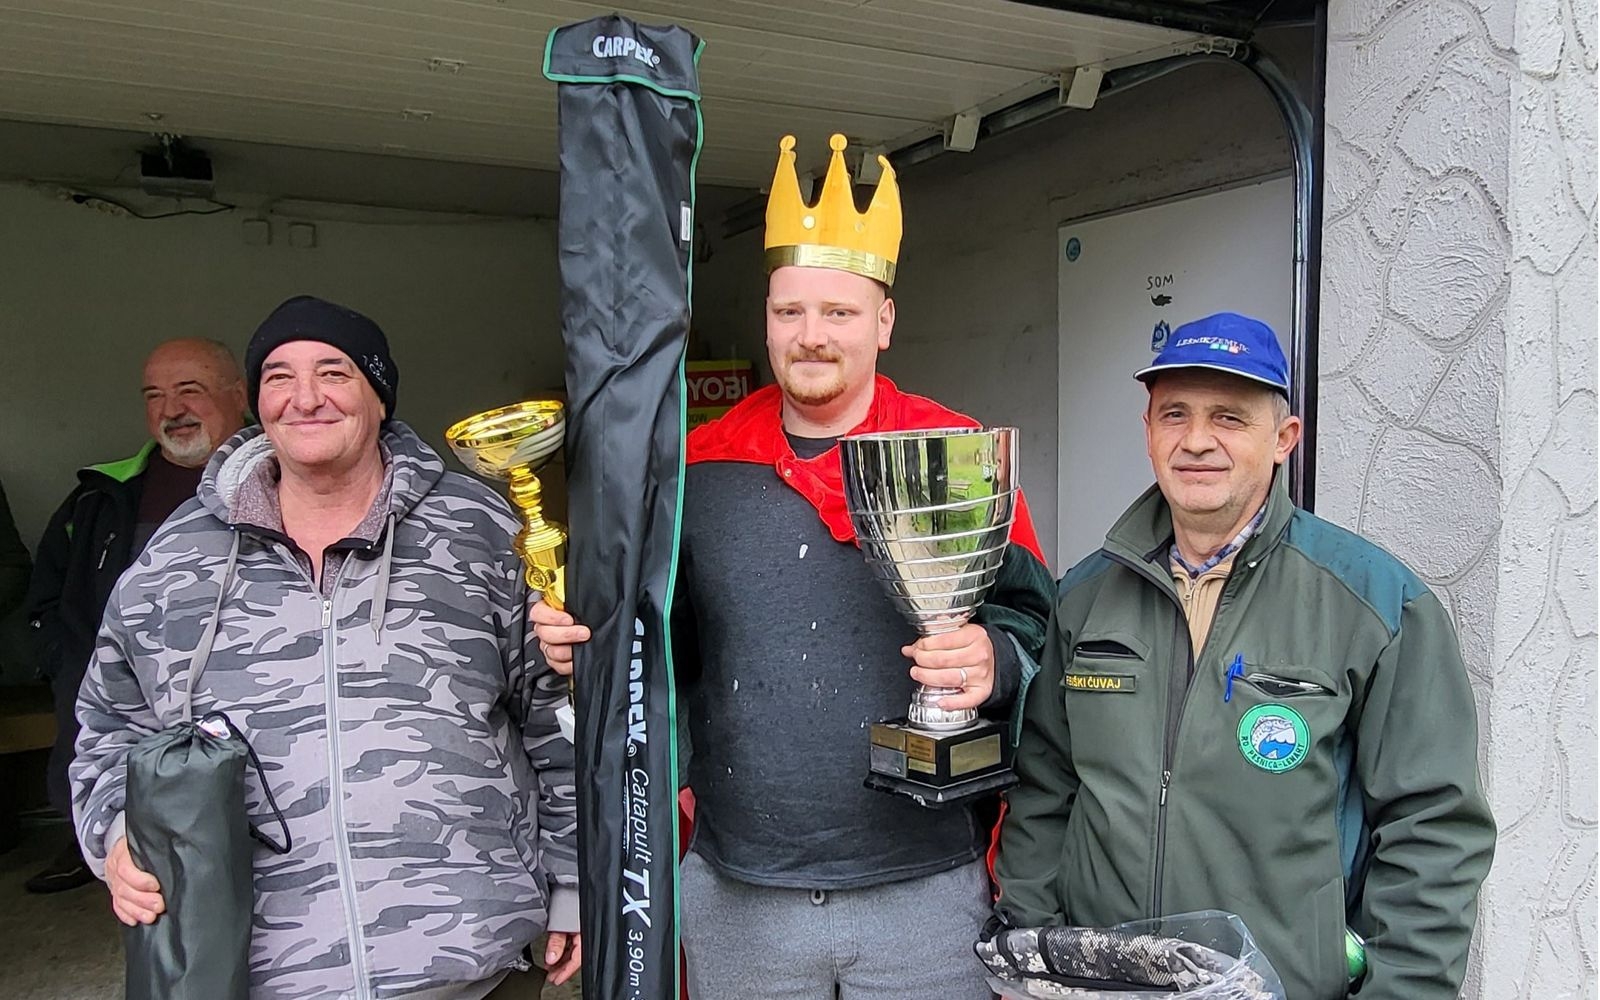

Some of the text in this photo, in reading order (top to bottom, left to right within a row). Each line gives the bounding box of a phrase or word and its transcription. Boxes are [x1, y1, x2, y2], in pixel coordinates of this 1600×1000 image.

[1146, 274, 1174, 290] SOM
[687, 375, 748, 401] YOBI
[1087, 676, 1121, 689] ČUVAJ
[1241, 735, 1250, 747] RD
[630, 768, 653, 864] Catapult
[622, 868, 652, 929] TX
